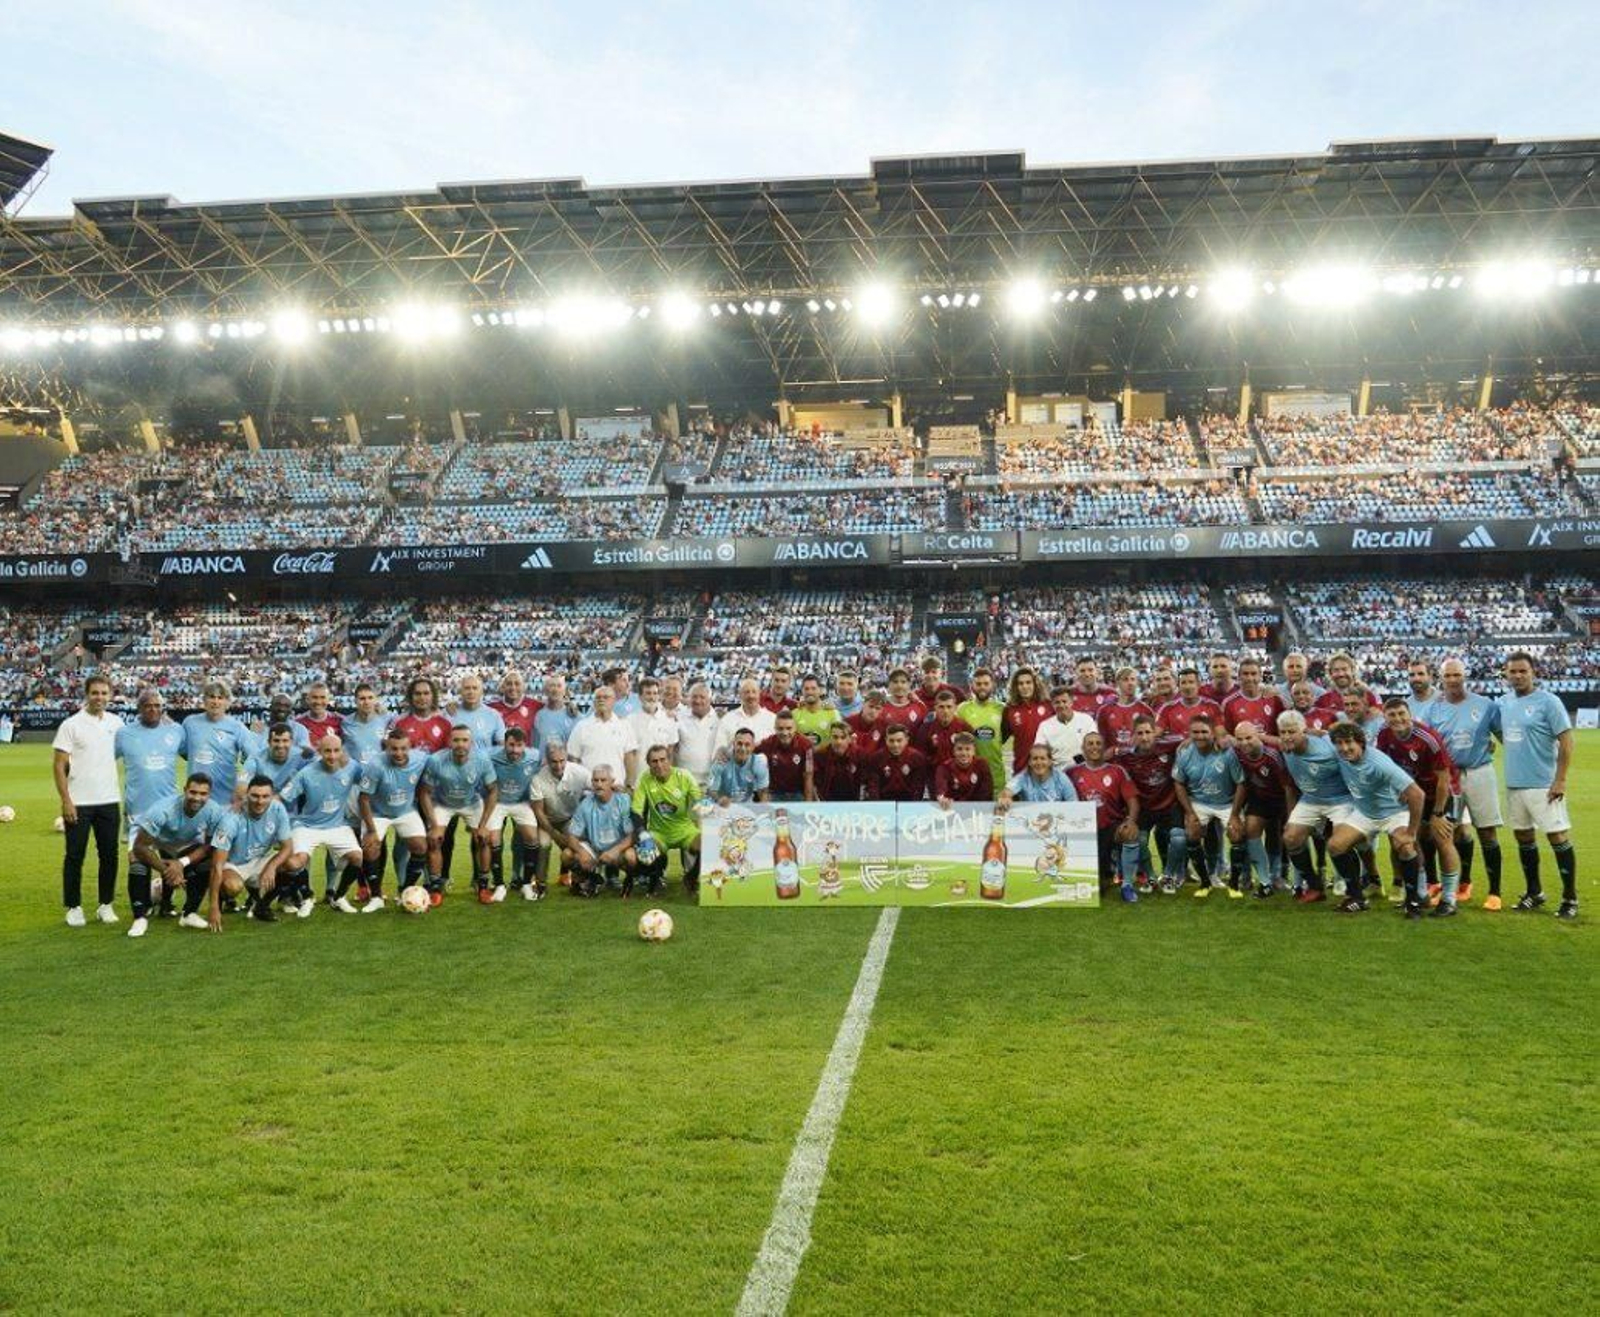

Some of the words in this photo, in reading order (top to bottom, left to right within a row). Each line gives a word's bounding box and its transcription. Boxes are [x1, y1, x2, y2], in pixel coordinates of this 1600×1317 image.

[1038, 537, 1102, 554] Estrella
[1105, 534, 1165, 553] Galicia
[1221, 530, 1319, 550] ABANCA
[1352, 527, 1433, 548] Recalvi
[412, 547, 486, 559] INVESTMENT
[592, 547, 654, 565] Estrella
[656, 545, 713, 562] Galicia
[775, 541, 868, 560] ABANCA
[15, 560, 67, 577] Galicia
[161, 556, 246, 574] ABANCA
[417, 561, 455, 572] GROUP
[803, 810, 891, 842] SEMPRE
